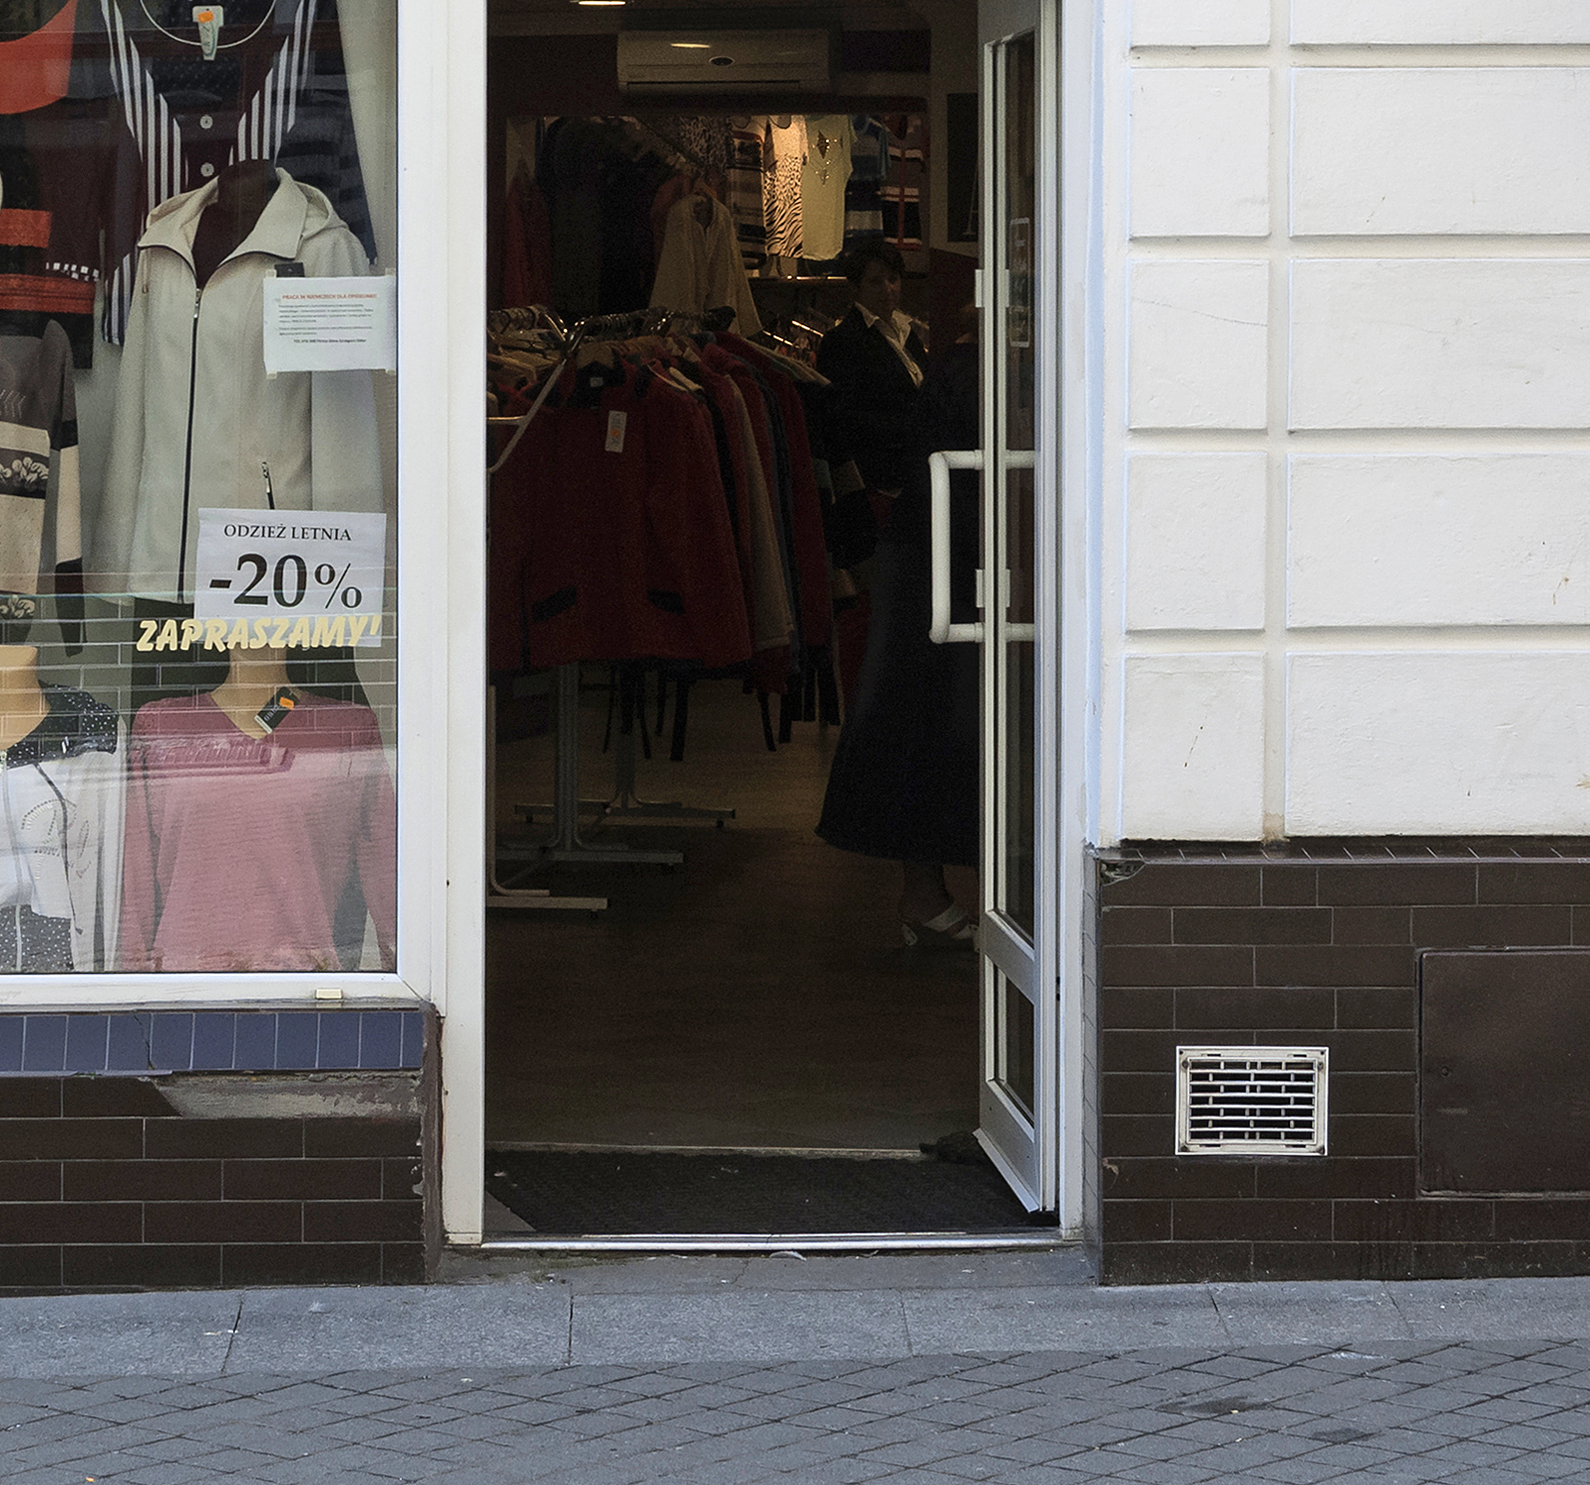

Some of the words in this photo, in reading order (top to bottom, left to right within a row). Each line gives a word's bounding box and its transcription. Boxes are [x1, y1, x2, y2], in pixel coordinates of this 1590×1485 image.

[223, 523, 287, 540] ODZIEŻ
[291, 526, 352, 542] LETNIA
[209, 552, 363, 609] -20%
